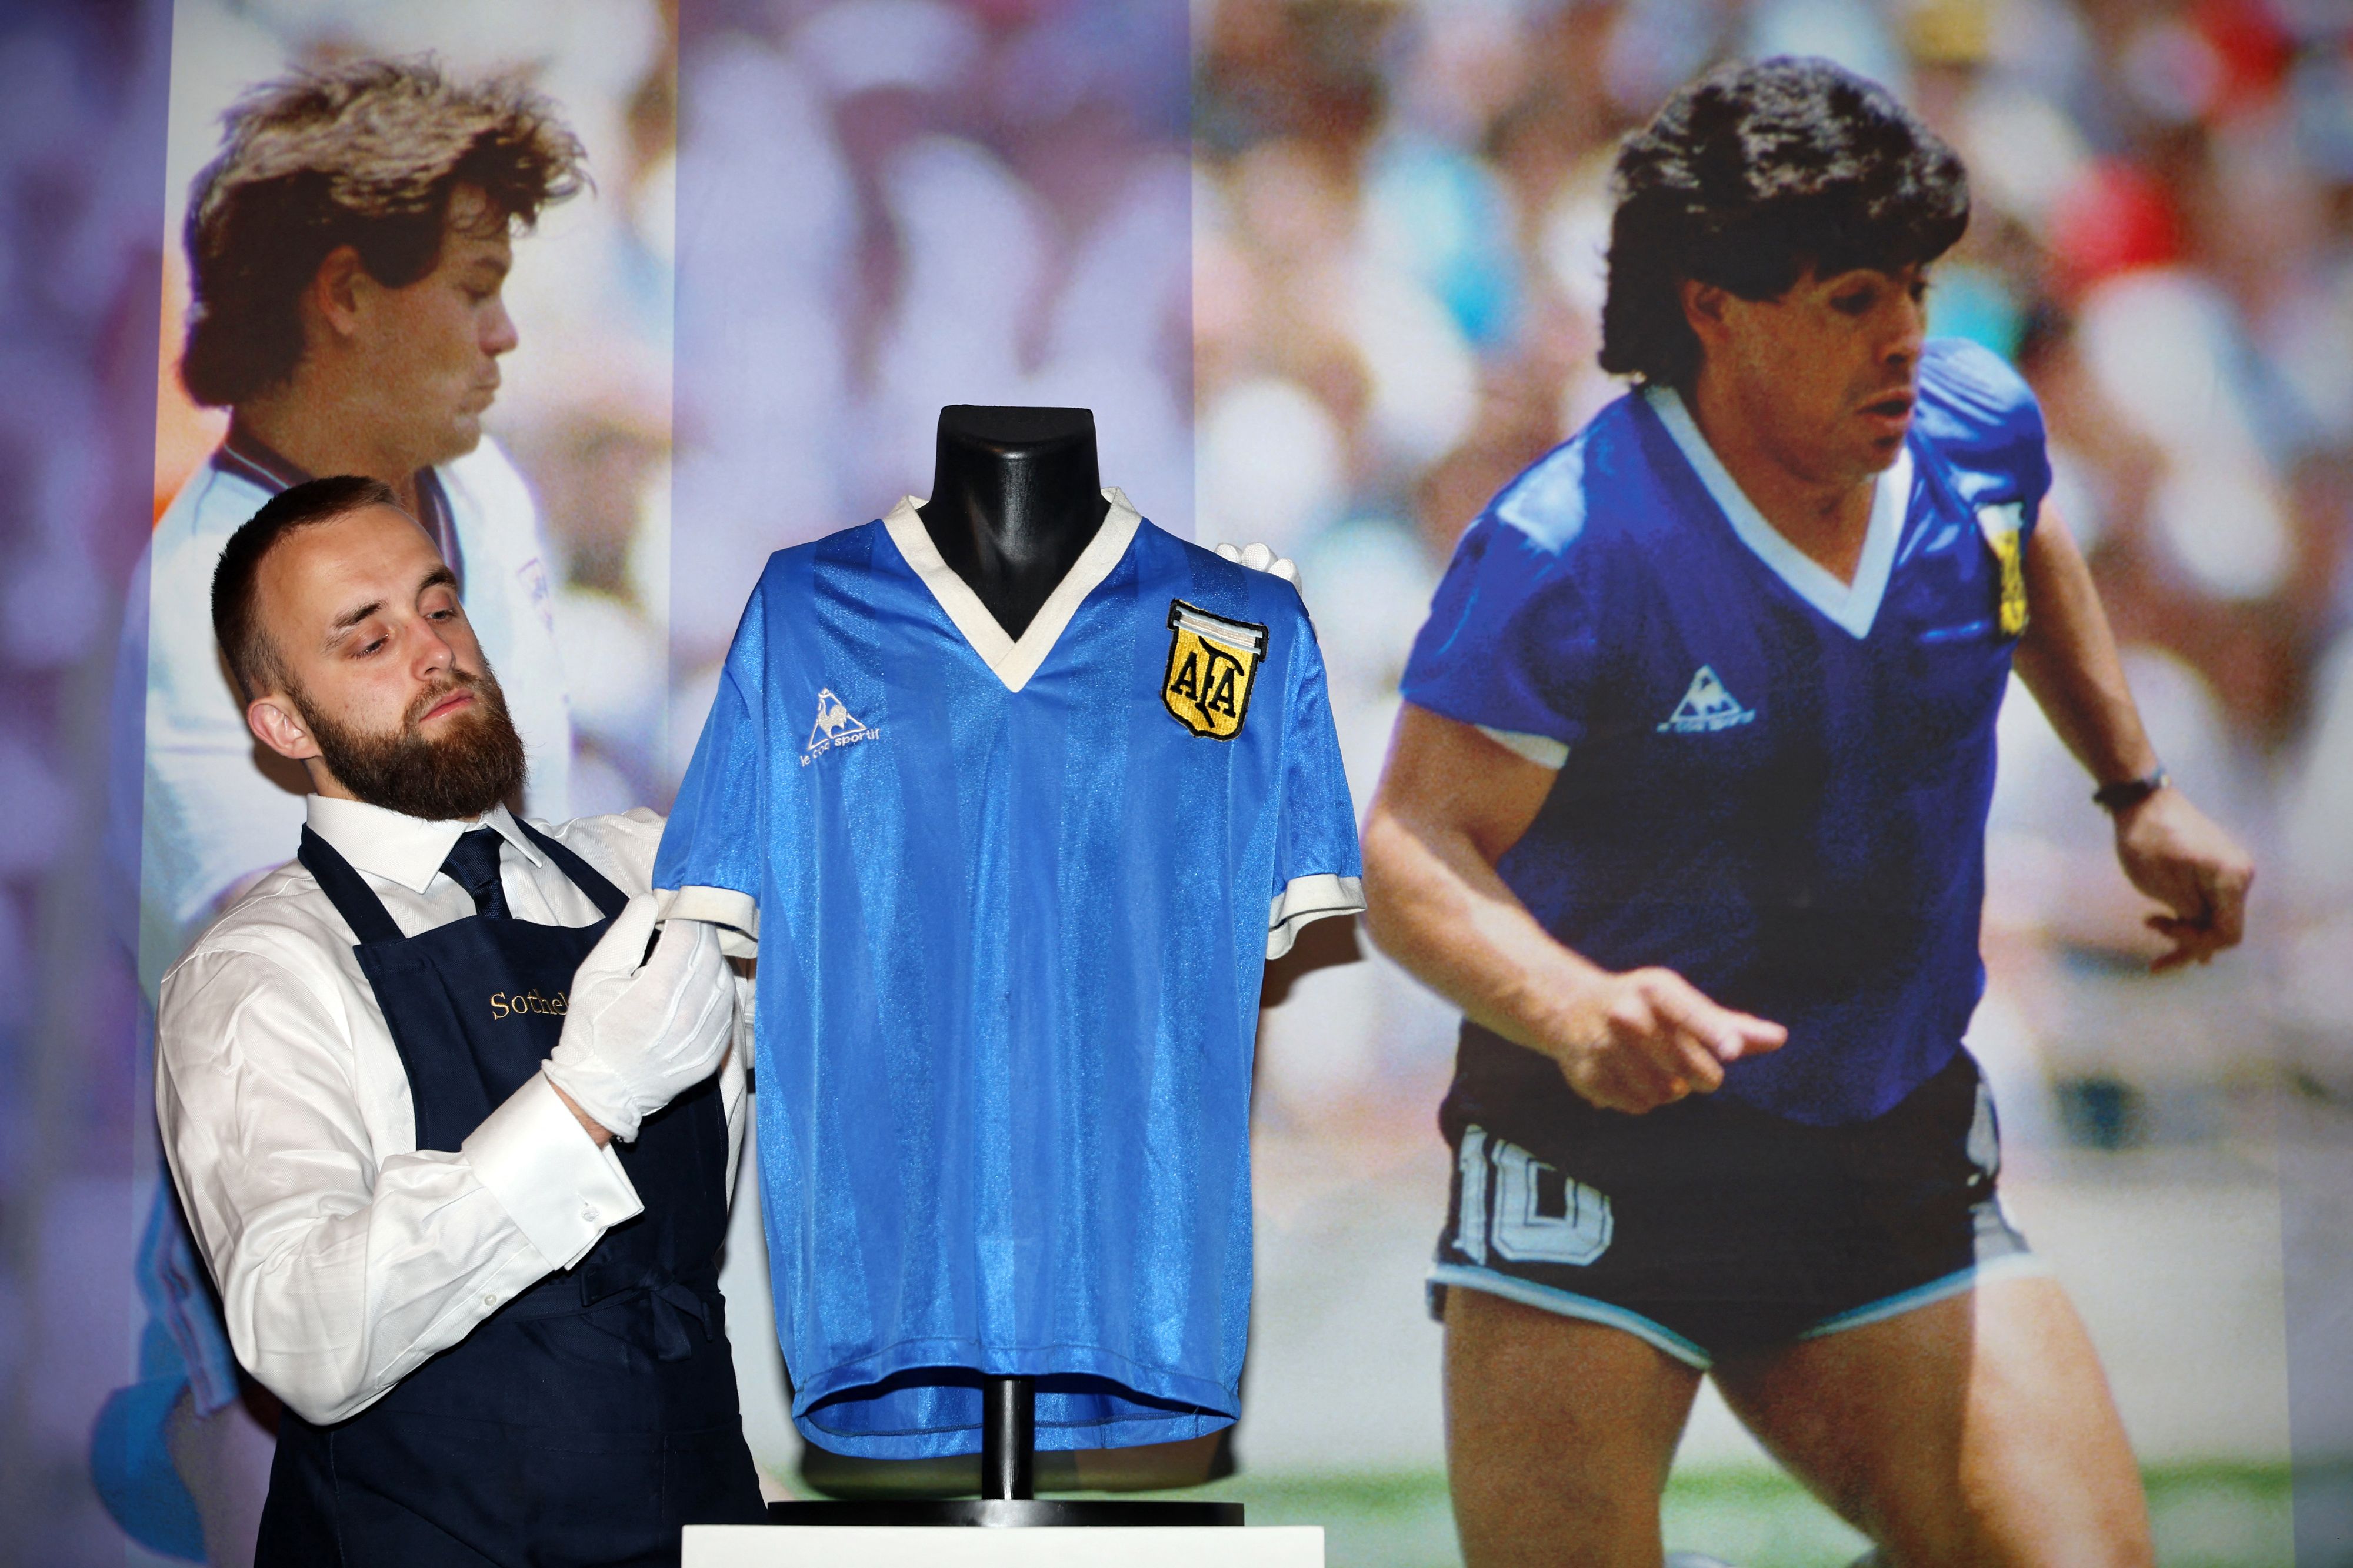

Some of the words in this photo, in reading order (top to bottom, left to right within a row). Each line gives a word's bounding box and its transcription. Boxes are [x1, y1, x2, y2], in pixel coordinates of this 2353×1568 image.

[1170, 635, 1244, 728] AFA
[800, 755, 811, 767] le
[812, 742, 831, 759] coq
[834, 728, 880, 747] sportif
